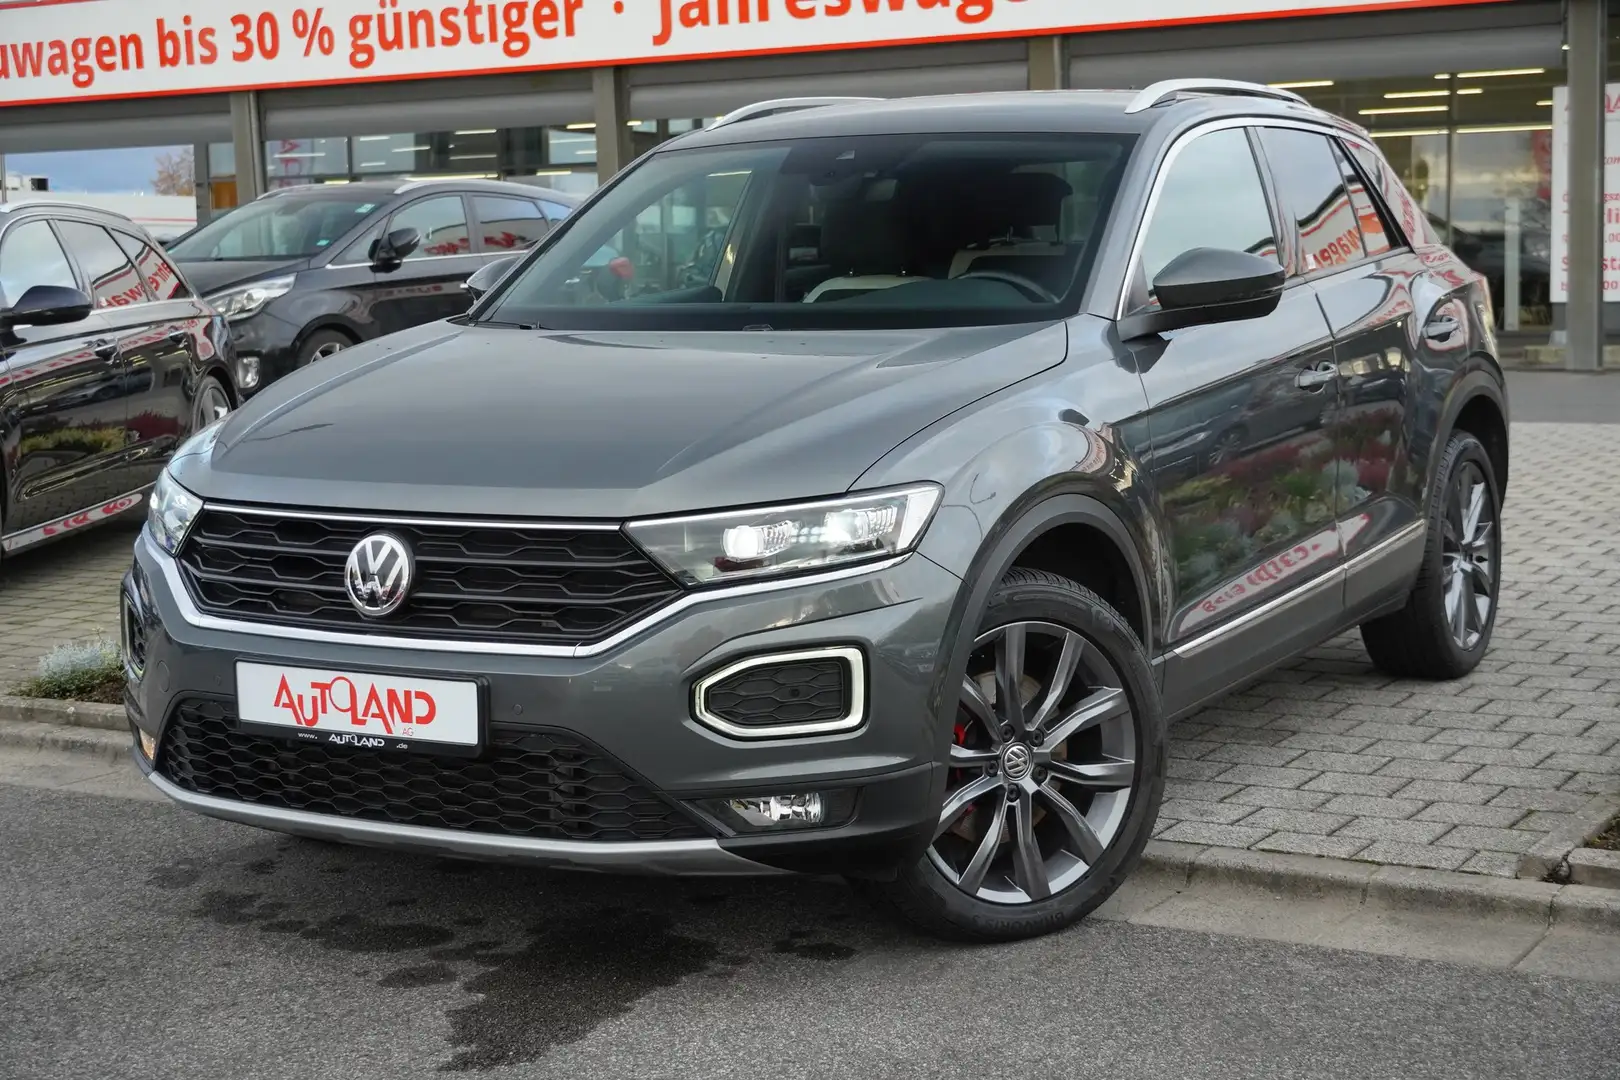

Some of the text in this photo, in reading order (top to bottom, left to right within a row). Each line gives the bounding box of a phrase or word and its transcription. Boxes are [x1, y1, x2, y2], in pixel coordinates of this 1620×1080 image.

[157, 15, 217, 67] bis
[231, 12, 279, 61] 30
[292, 8, 334, 56] %
[349, 0, 583, 69] günstiger
[274, 673, 437, 734] AUTOLAND
[297, 731, 408, 750] www. AUTOLAND .de
[402, 727, 414, 737] AG
